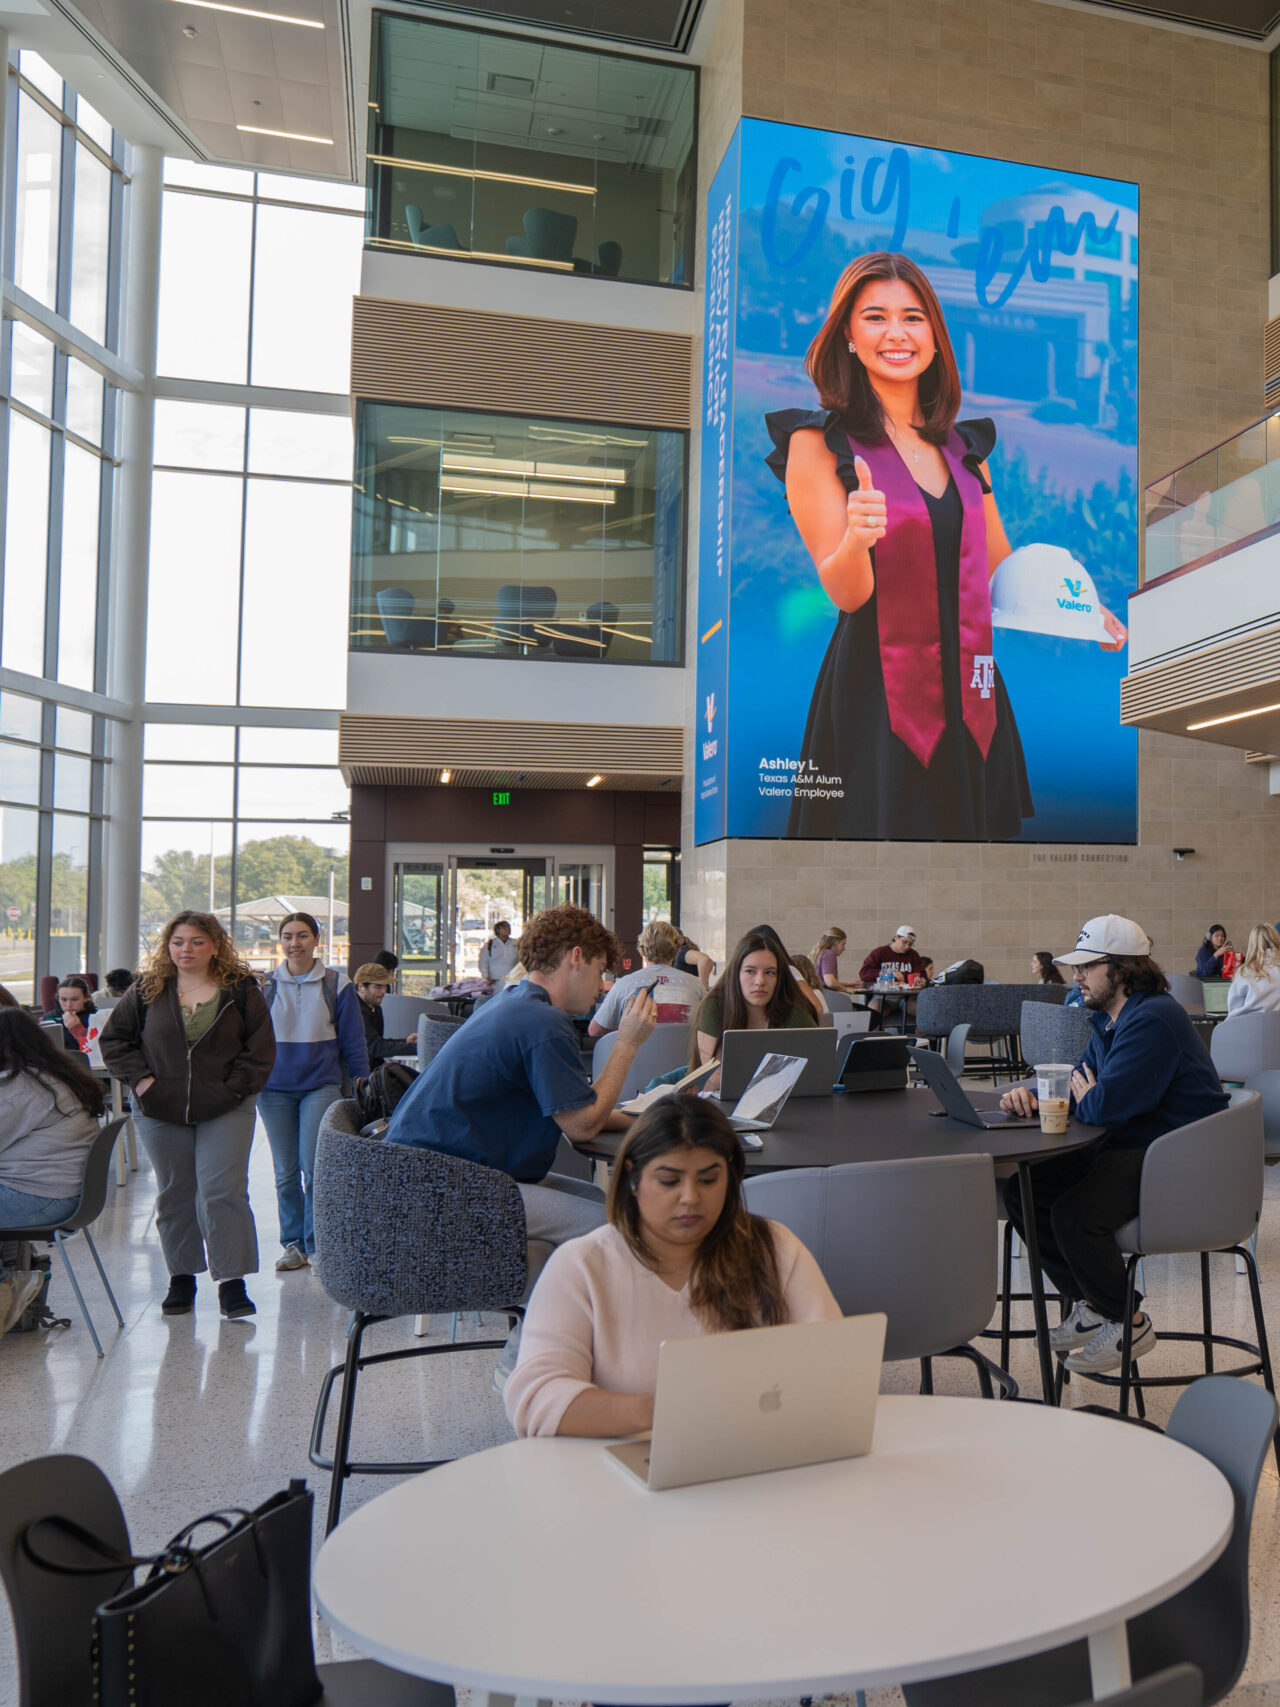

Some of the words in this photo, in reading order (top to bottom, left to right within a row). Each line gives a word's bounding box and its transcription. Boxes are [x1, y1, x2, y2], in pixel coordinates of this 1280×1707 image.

[761, 147, 910, 268] Gig
[722, 193, 732, 360] INDUSTRY
[706, 223, 718, 426] EXCELLENCE
[713, 209, 724, 427] INNOVATION
[716, 372, 728, 576] LEADERSHIP
[1056, 597, 1092, 613] Valero
[493, 791, 510, 806] EXIT
[758, 773, 788, 783] Texas
[790, 774, 813, 784] A&M
[815, 774, 842, 785] Alum
[758, 786, 792, 797] Valero
[794, 787, 845, 800] Employee
[759, 757, 806, 773] Ashley
[808, 759, 819, 771] L.
